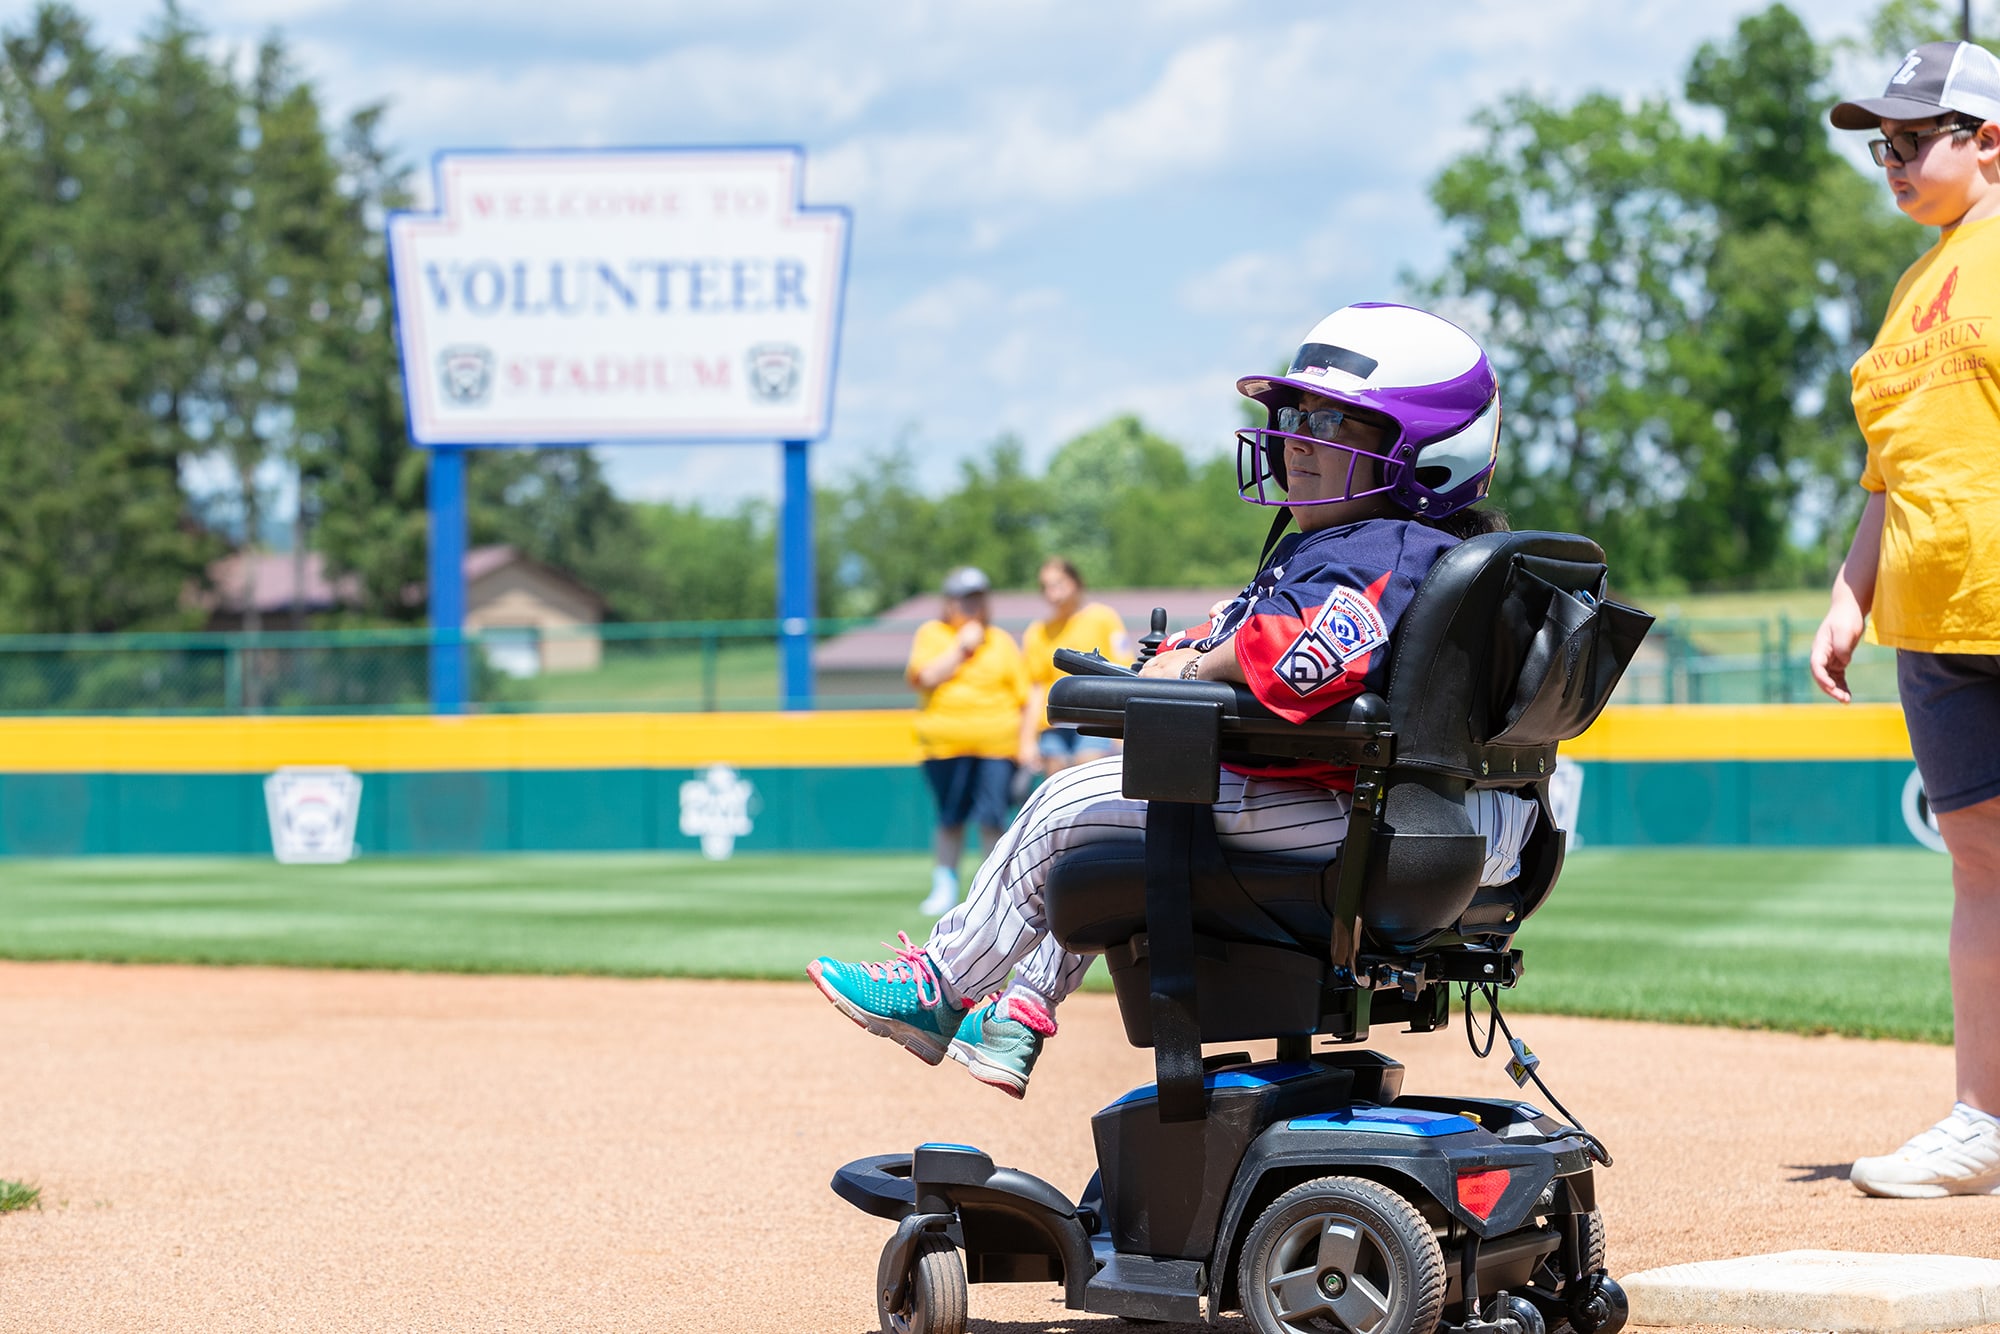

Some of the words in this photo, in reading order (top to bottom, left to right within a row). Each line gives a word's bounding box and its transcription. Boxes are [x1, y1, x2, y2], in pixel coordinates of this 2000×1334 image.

[471, 188, 681, 217] WELCOME
[712, 187, 769, 214] TO
[424, 259, 809, 315] VOLUNTEER
[1871, 338, 1934, 371] WOLF
[1939, 322, 1984, 352] RUN
[505, 355, 732, 393] STADIUM
[1869, 368, 1938, 401] Veteriny
[1941, 354, 1987, 376] Clinic
[1338, 590, 1370, 614] CHALLENGER
[1367, 612, 1383, 638] DIVISION
